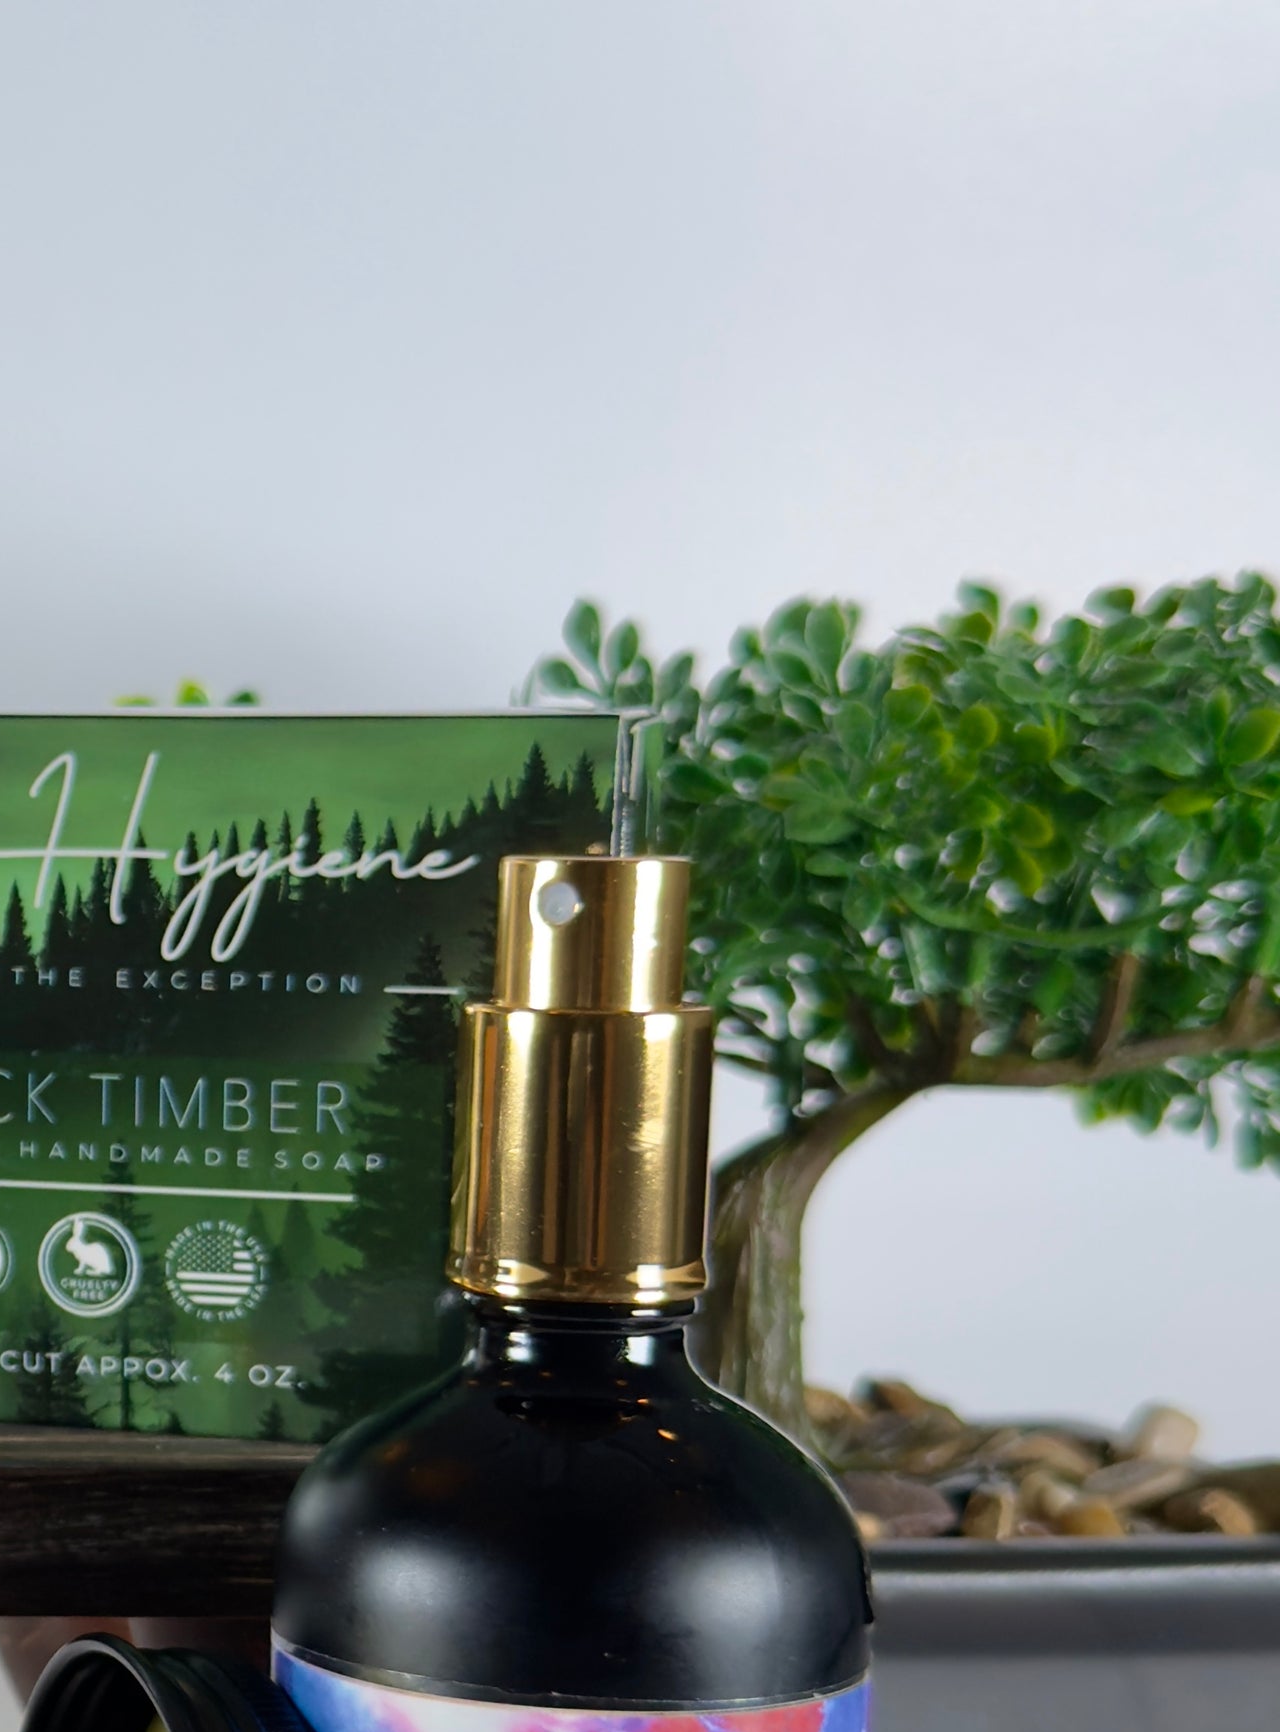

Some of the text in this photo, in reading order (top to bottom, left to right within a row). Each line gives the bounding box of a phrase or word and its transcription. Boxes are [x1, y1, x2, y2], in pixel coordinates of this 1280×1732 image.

[10, 966, 85, 988] THE
[114, 967, 361, 994] EXCEPTION
[89, 1072, 348, 1135] TIMBER
[19, 1140, 251, 1169] HANDMADE
[274, 1150, 386, 1172] SOAP
[60, 1277, 119, 1290] CRUELTY
[72, 1289, 106, 1300] FREE
[75, 1354, 200, 1383] APPOX.
[213, 1361, 234, 1384] 4
[247, 1363, 307, 1389] OZ.
